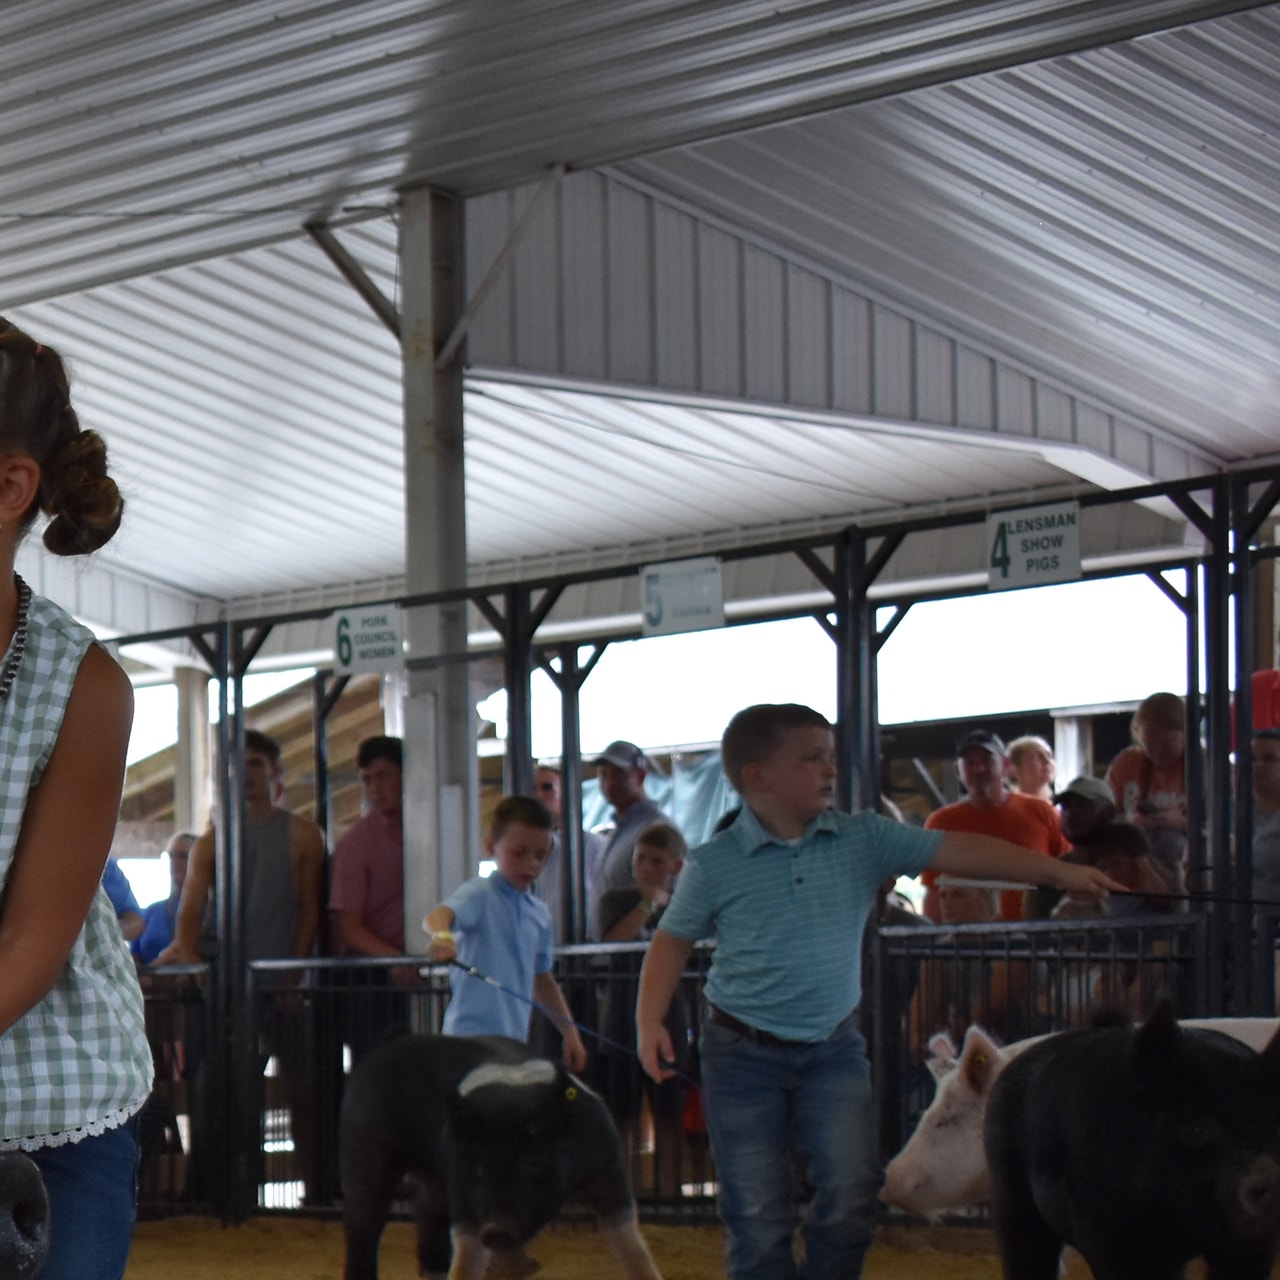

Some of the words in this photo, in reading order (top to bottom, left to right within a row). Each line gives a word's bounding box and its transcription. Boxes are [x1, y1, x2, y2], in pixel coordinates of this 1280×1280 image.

[1007, 512, 1076, 534] LENSMAN
[991, 521, 1010, 578] 4
[1021, 534, 1063, 552] SHOW
[1026, 555, 1059, 571] PIGS
[645, 574, 663, 627] 5
[361, 616, 388, 627] PORK
[336, 616, 352, 667] 6
[354, 631, 398, 644] COUNCIL
[358, 647, 395, 659] WOMEN
